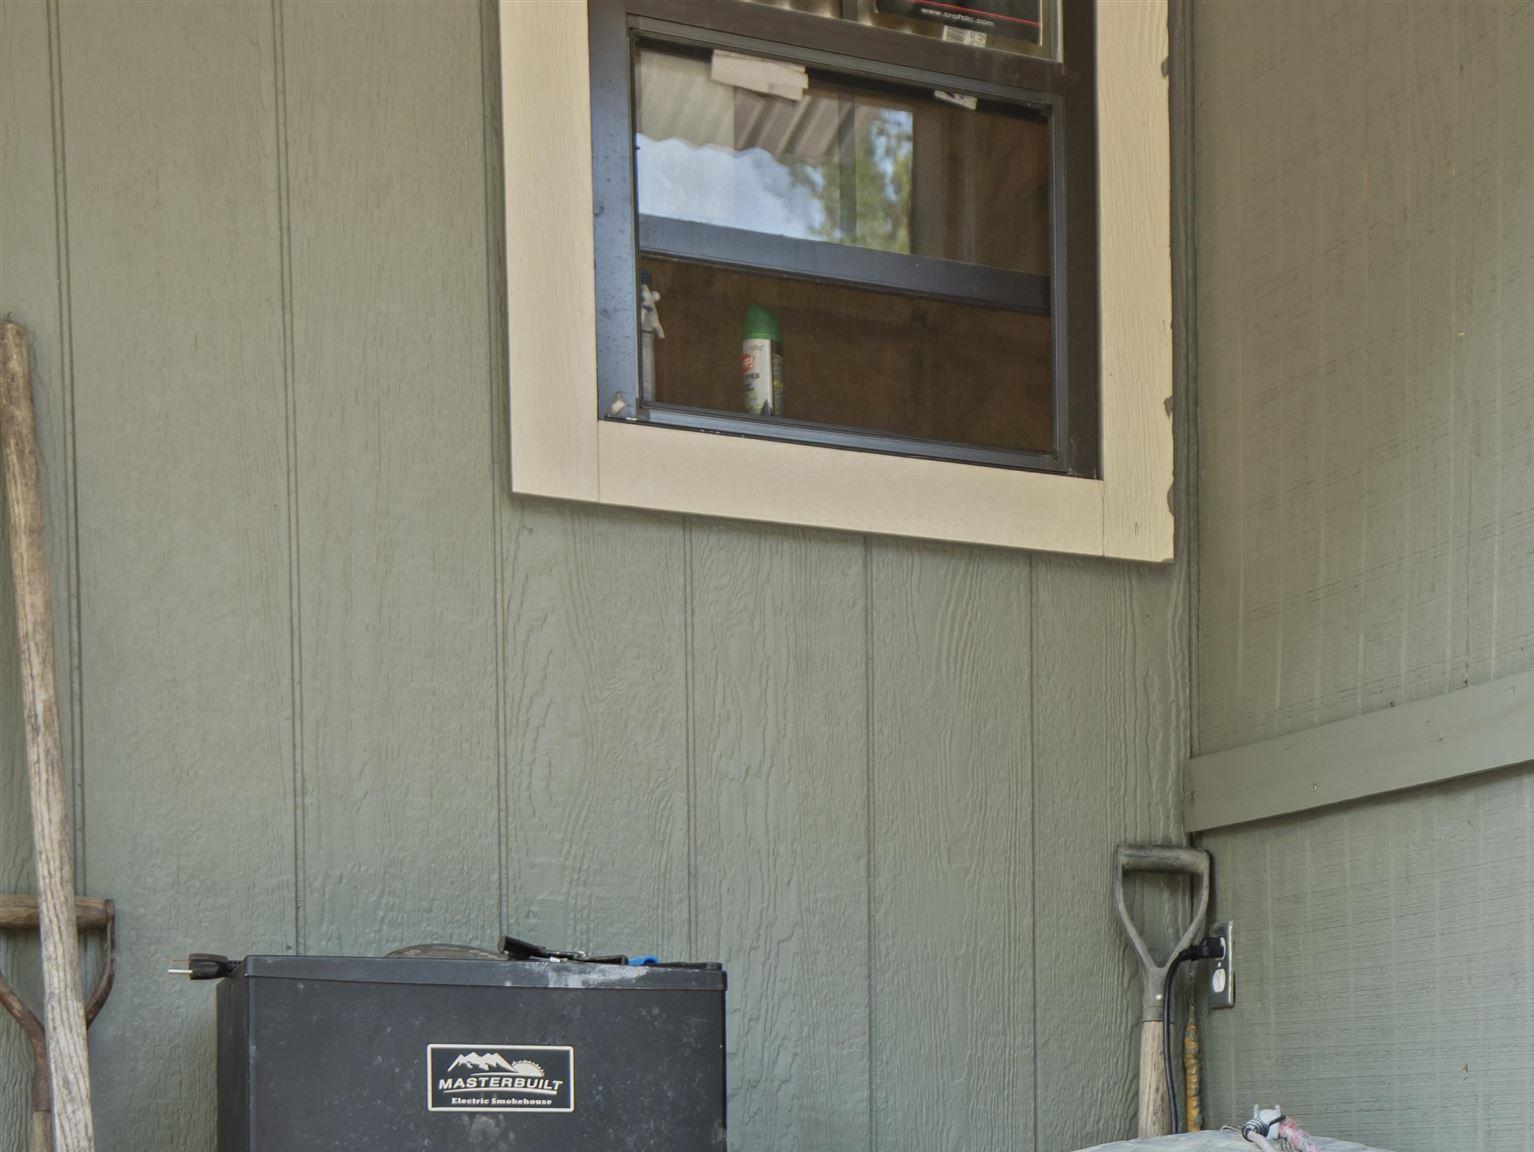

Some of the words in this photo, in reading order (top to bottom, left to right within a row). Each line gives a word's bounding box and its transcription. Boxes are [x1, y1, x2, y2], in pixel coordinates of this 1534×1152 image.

[438, 1077, 564, 1091] MASTERBUILT
[451, 1097, 490, 1106] Electric
[491, 1097, 553, 1106] Smokehouse
